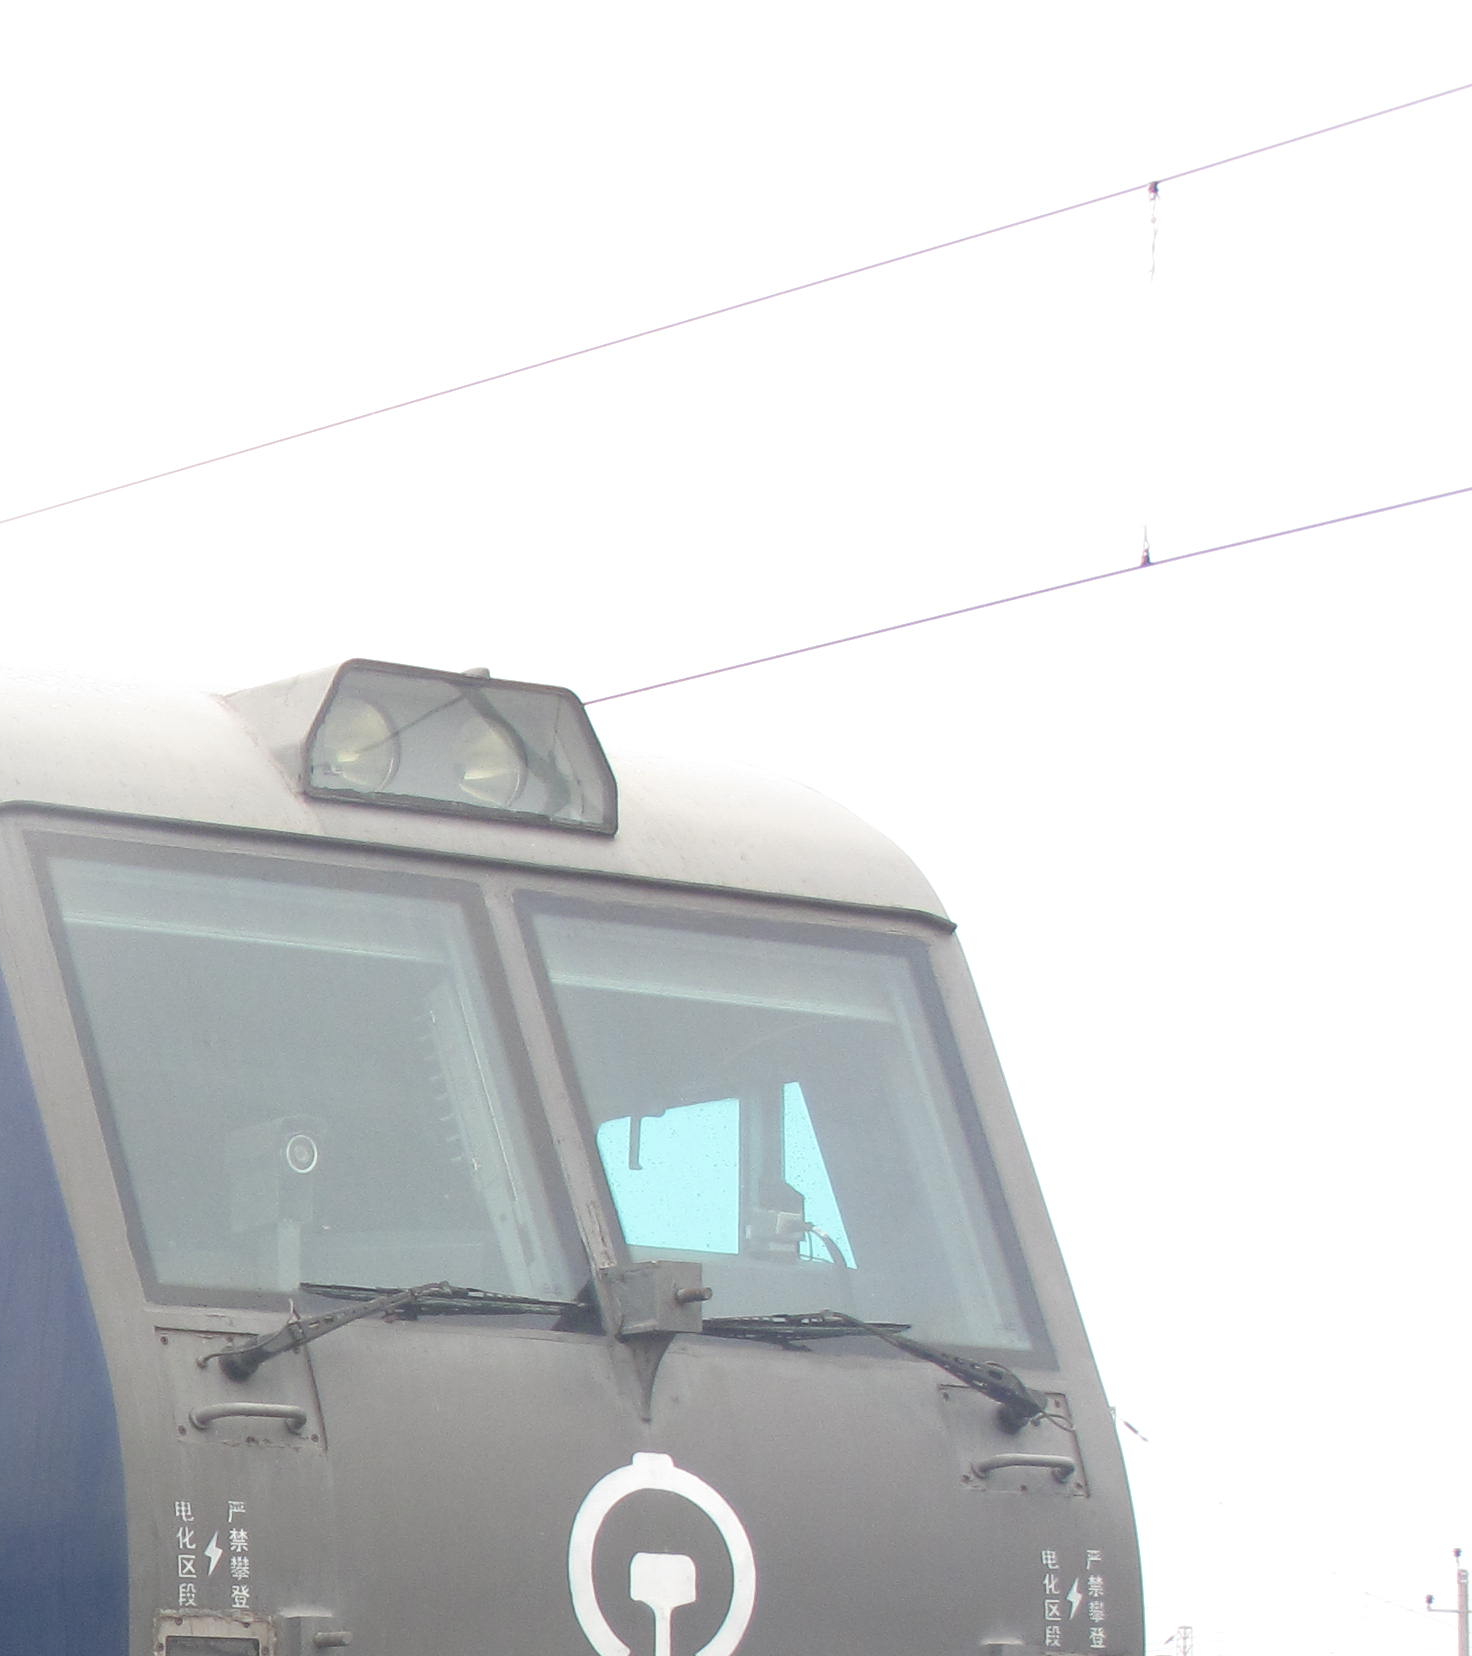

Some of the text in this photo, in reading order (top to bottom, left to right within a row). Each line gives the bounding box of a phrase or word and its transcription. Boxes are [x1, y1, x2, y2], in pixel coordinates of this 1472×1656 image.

[174, 1500, 198, 1606] 电化区段
[227, 1500, 251, 1608] 严禁攀登
[1041, 1550, 1062, 1647] 电化区段
[1086, 1549, 1106, 1649] 严禁攀登
